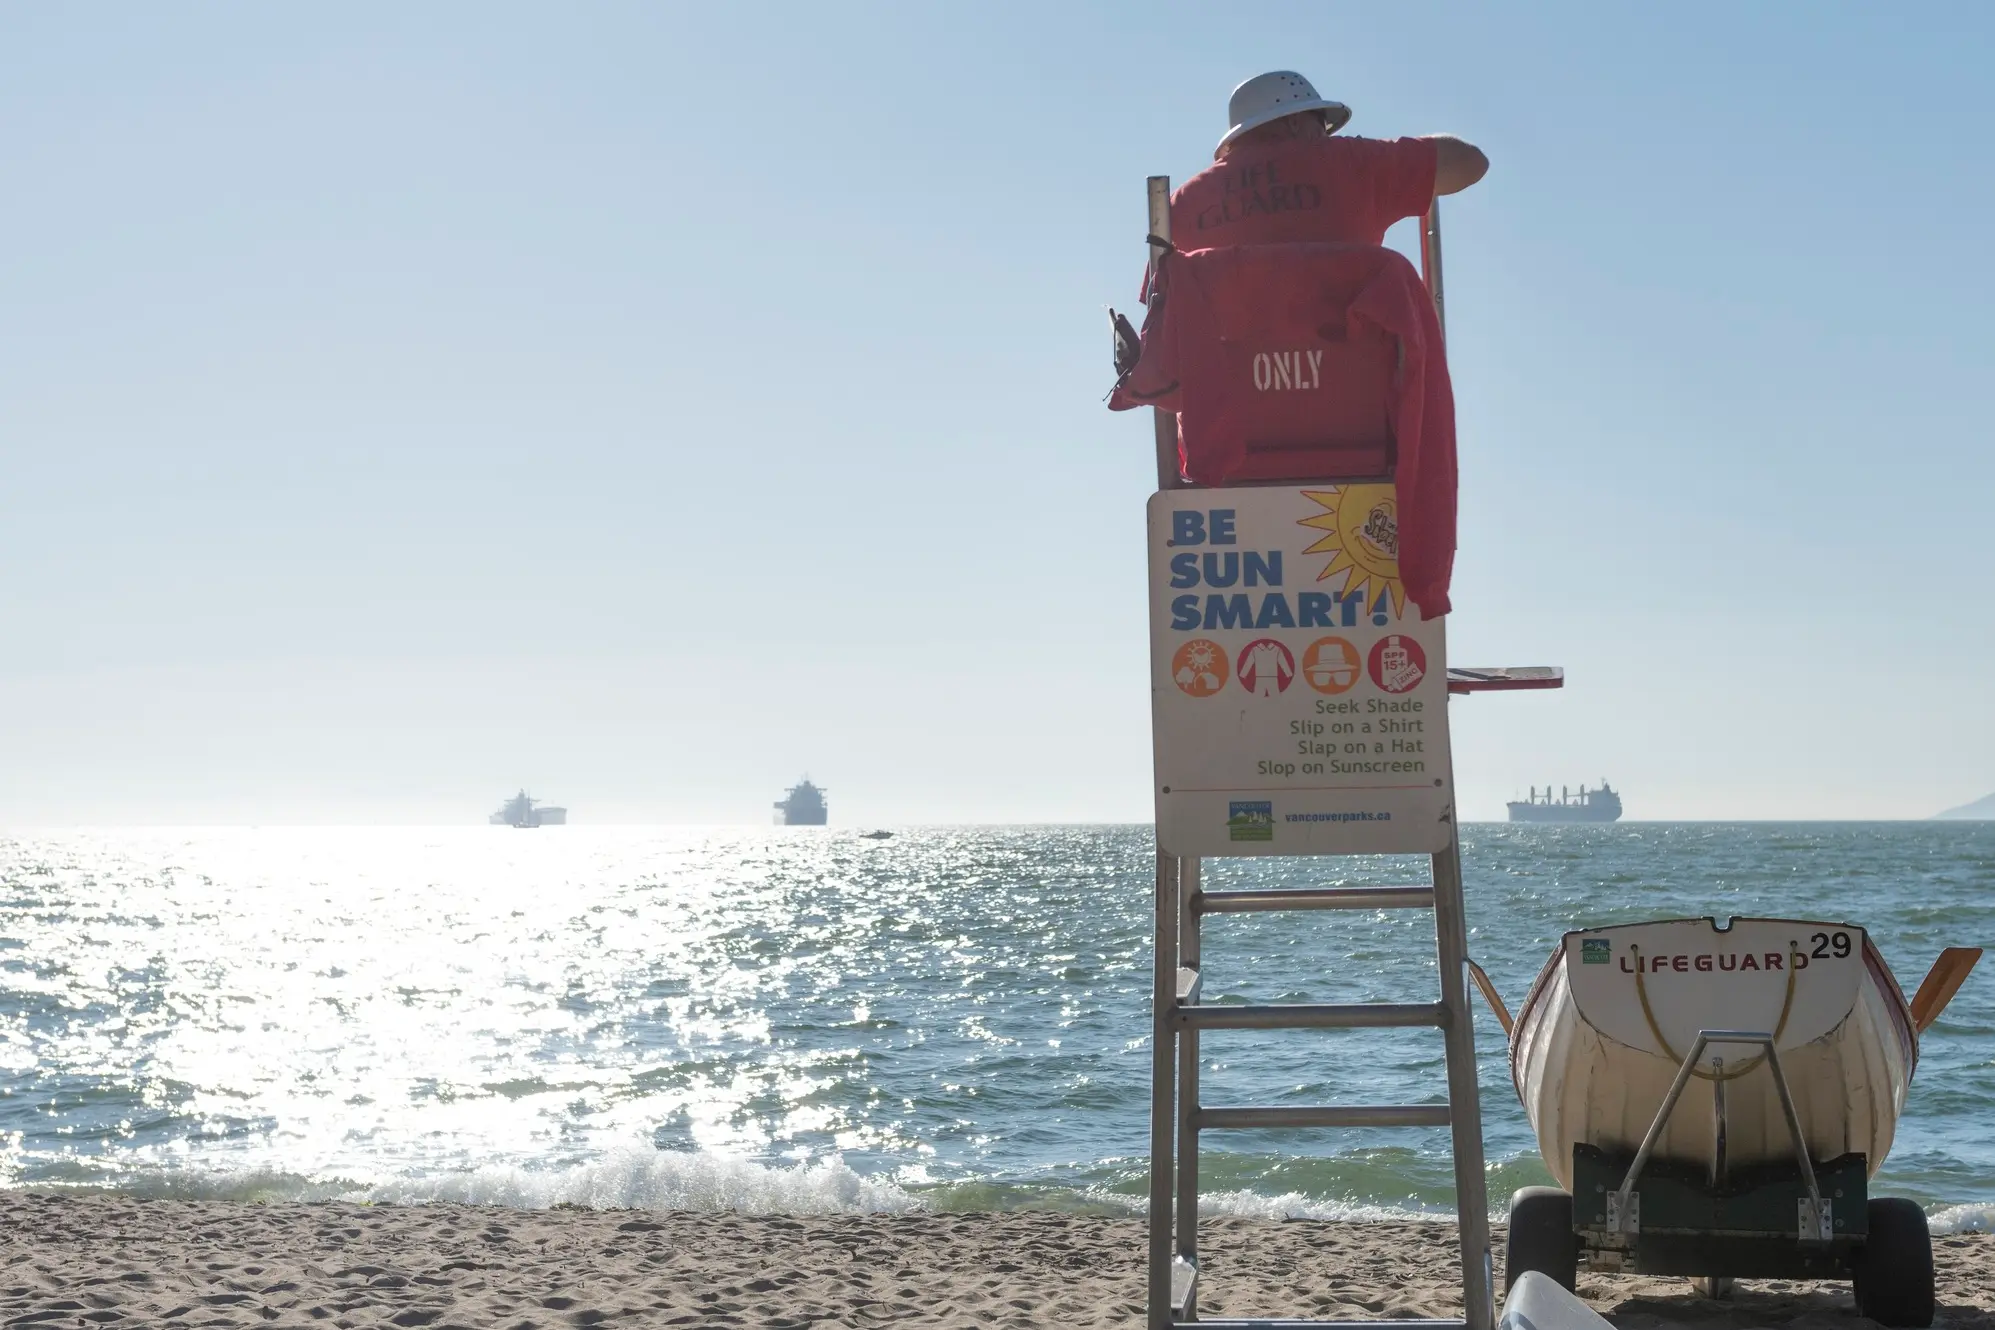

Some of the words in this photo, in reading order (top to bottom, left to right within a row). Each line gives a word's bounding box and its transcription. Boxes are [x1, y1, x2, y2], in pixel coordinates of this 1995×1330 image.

[1198, 184, 1321, 229] GUARD
[1253, 350, 1322, 391] ONLY
[1172, 509, 1236, 546] BE
[1170, 551, 1282, 588] SUN
[1170, 588, 1388, 631] SMART!
[1316, 699, 1359, 714] Seek
[1368, 698, 1423, 713] Shade
[1290, 720, 1324, 736] Slip
[1332, 723, 1354, 733] on
[1362, 722, 1371, 733] a
[1379, 718, 1423, 733] Shirt
[1298, 741, 1336, 757] Slap
[1344, 743, 1366, 753] on
[1374, 742, 1384, 753] a
[1392, 739, 1424, 753] Hat
[1258, 761, 1295, 777] Slop
[1302, 763, 1324, 773] on
[1331, 760, 1425, 773] Sunscreen
[1285, 812, 1391, 823] vancouverparks.ca
[1620, 952, 1809, 974] LIFEGUARD
[1811, 932, 1852, 959] 29
